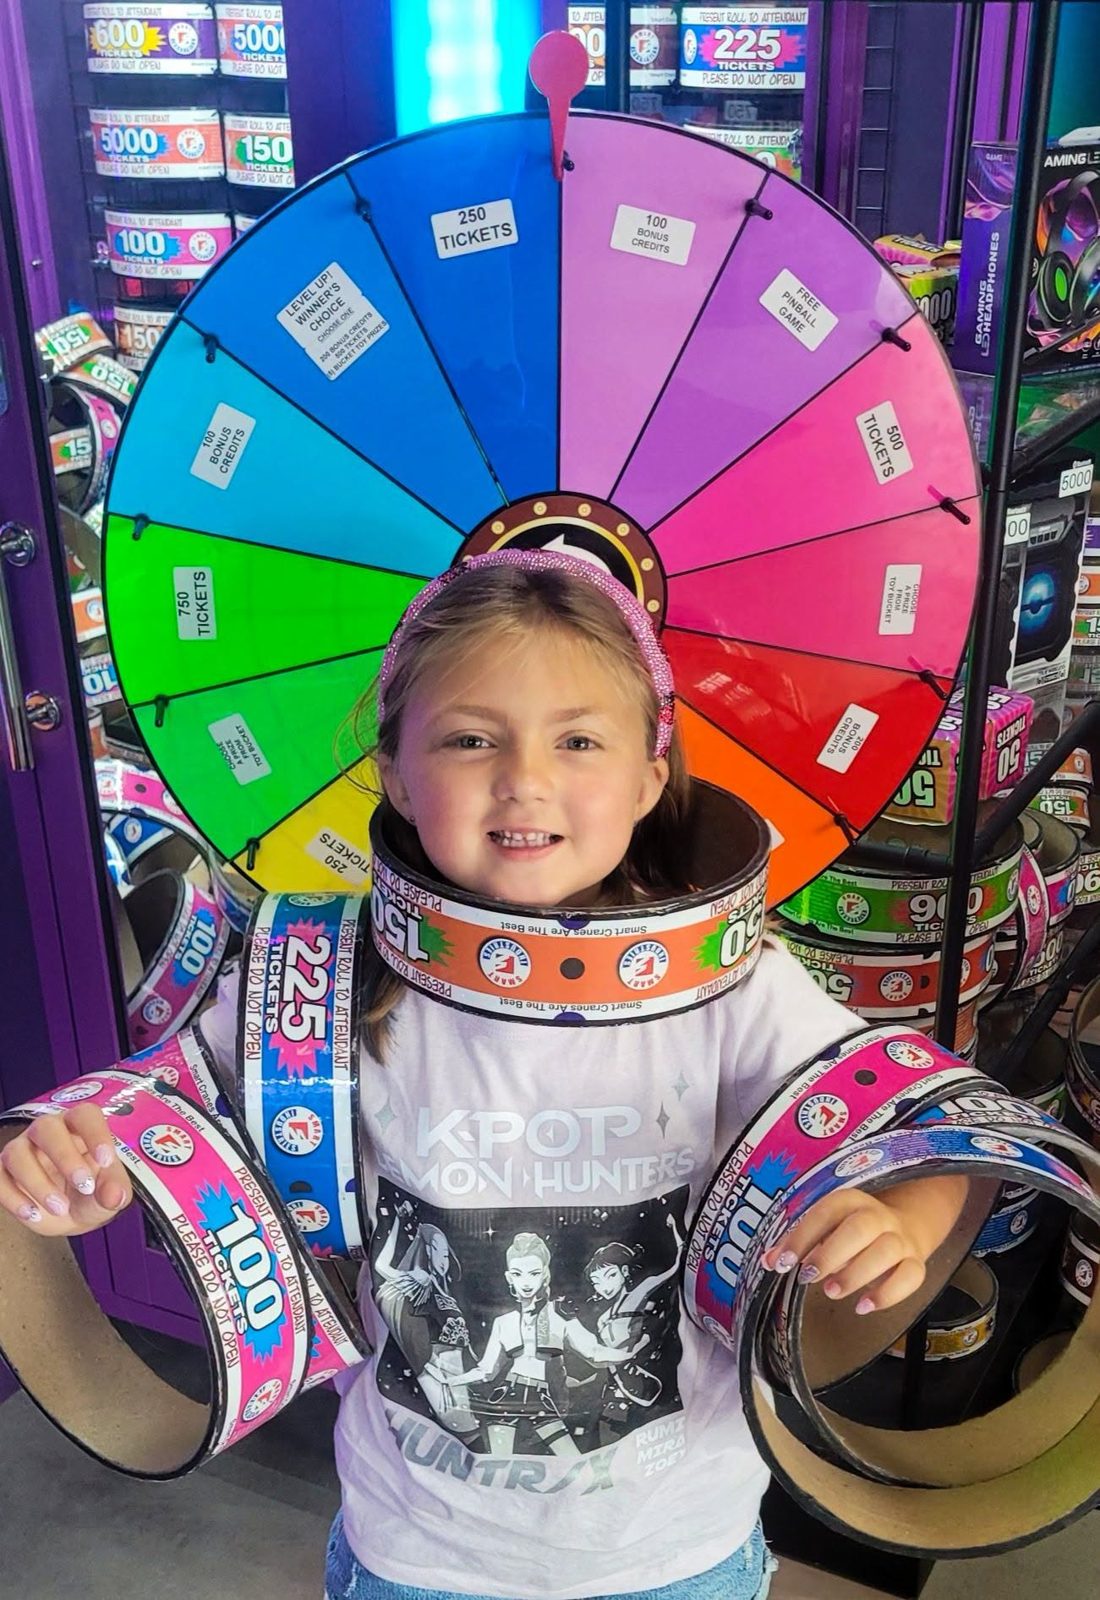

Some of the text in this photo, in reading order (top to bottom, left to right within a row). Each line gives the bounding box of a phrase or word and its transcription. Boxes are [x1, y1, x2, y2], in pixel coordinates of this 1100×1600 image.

[727, 12, 746, 22] ROLL
[748, 12, 760, 22] TO
[761, 12, 806, 23] ATTENDANT
[94, 19, 145, 48] 600
[713, 29, 782, 60] 225
[100, 50, 142, 58] TICKETS
[138, 62, 161, 70] OPEN
[718, 62, 775, 70] TICKETS
[255, 64, 282, 74] DO NOT
[702, 72, 796, 86] PLEASE DO NOT OPEN
[102, 127, 158, 154] 5000
[242, 136, 293, 164] 150
[108, 154, 150, 163] TICKETS
[148, 165, 170, 174] OPEN
[246, 163, 290, 172] TICKETS
[1044, 152, 1087, 168] AMING
[257, 172, 284, 184] DO NOT
[458, 207, 486, 225] 250
[646, 214, 667, 229] 100
[118, 230, 166, 255] 100
[440, 222, 513, 250] TICKETS
[632, 238, 670, 254] CREDITS
[637, 228, 669, 242] BONUS
[285, 271, 334, 317] LEVEL UP!
[984, 232, 1000, 334] HEADPHONES
[296, 282, 341, 326] WINNER'S
[782, 291, 816, 328] PINBALL
[796, 287, 821, 312] FREE
[309, 297, 346, 332] CHOICE
[317, 308, 355, 343] CHOOSE ONE
[778, 306, 806, 334] GAME
[975, 280, 987, 346] GAMING
[329, 312, 373, 354] BONUS CREDITS
[333, 350, 356, 371] BUCKET
[367, 320, 388, 340] PRIZES
[344, 328, 369, 350] TICKETS
[91, 364, 134, 398] 150
[203, 430, 216, 448] 100
[209, 427, 232, 464] BONUS
[864, 414, 894, 478] TICKETS
[886, 425, 904, 450] 500
[220, 428, 244, 474] CREDITS
[1061, 469, 1092, 490] 5000
[888, 576, 896, 592] TOY
[176, 592, 191, 616] 750
[194, 572, 210, 636] TICKETS
[827, 717, 852, 754] CREDITS
[838, 722, 861, 754] BONUS
[852, 736, 864, 751] 200
[997, 714, 1026, 749] TICKETS
[998, 738, 1020, 783] 50
[320, 833, 370, 874] TICKETS
[324, 856, 348, 874] 250
[390, 872, 442, 912] PLEASE DO
[891, 880, 929, 890] PRESENT
[710, 894, 738, 918] OPEN
[371, 885, 430, 963] 150
[501, 922, 648, 938] Smart Cranes Are The Best
[181, 918, 217, 976] 100
[896, 933, 932, 943] PLEASE
[819, 950, 854, 965] PLEASE
[264, 942, 284, 1034] TICKETS
[280, 934, 332, 1042] 225
[411, 971, 452, 998] PRESENT
[488, 972, 523, 986] SMART
[627, 975, 661, 988] SMART
[246, 926, 270, 1060] PLEASE DO NOT OPEN
[334, 919, 356, 1071] PRESENT ROLL TO ATTENDANT
[500, 997, 642, 1014] Smart Cranes Are The Best
[840, 1041, 866, 1060] Cranes
[808, 1070, 824, 1083] The
[822, 1058, 838, 1070] Are
[190, 1064, 215, 1112] Smart Cranes
[790, 1082, 810, 1100] Best
[901, 1080, 926, 1098] Cranes
[926, 1074, 944, 1086] Smart
[171, 1102, 186, 1115] The
[186, 1114, 206, 1132] Best
[870, 1111, 884, 1124] The
[882, 1099, 896, 1112] Are
[938, 1096, 1042, 1118] 100
[308, 1113, 322, 1147] SMART
[417, 1105, 642, 1158] KPOP
[823, 1111, 848, 1136] SMART
[850, 1125, 868, 1142] Best
[166, 1126, 192, 1150] SMART
[121, 1146, 140, 1166] Best
[534, 1148, 696, 1200] HUNTERS
[687, 1141, 754, 1273] PLEASE DO NOT OPEN
[704, 1174, 752, 1263] TICKETS
[234, 1166, 306, 1336] PRESENT ROLL TO ATTENDANT
[216, 1202, 285, 1332] 100
[172, 1214, 240, 1370] PLEASE DO NOT OPEN
[202, 1228, 250, 1336] TICKETS
[310, 1292, 324, 1306] TO
[315, 1308, 350, 1346] ATTENDANT
[637, 1433, 686, 1465] MIRA
